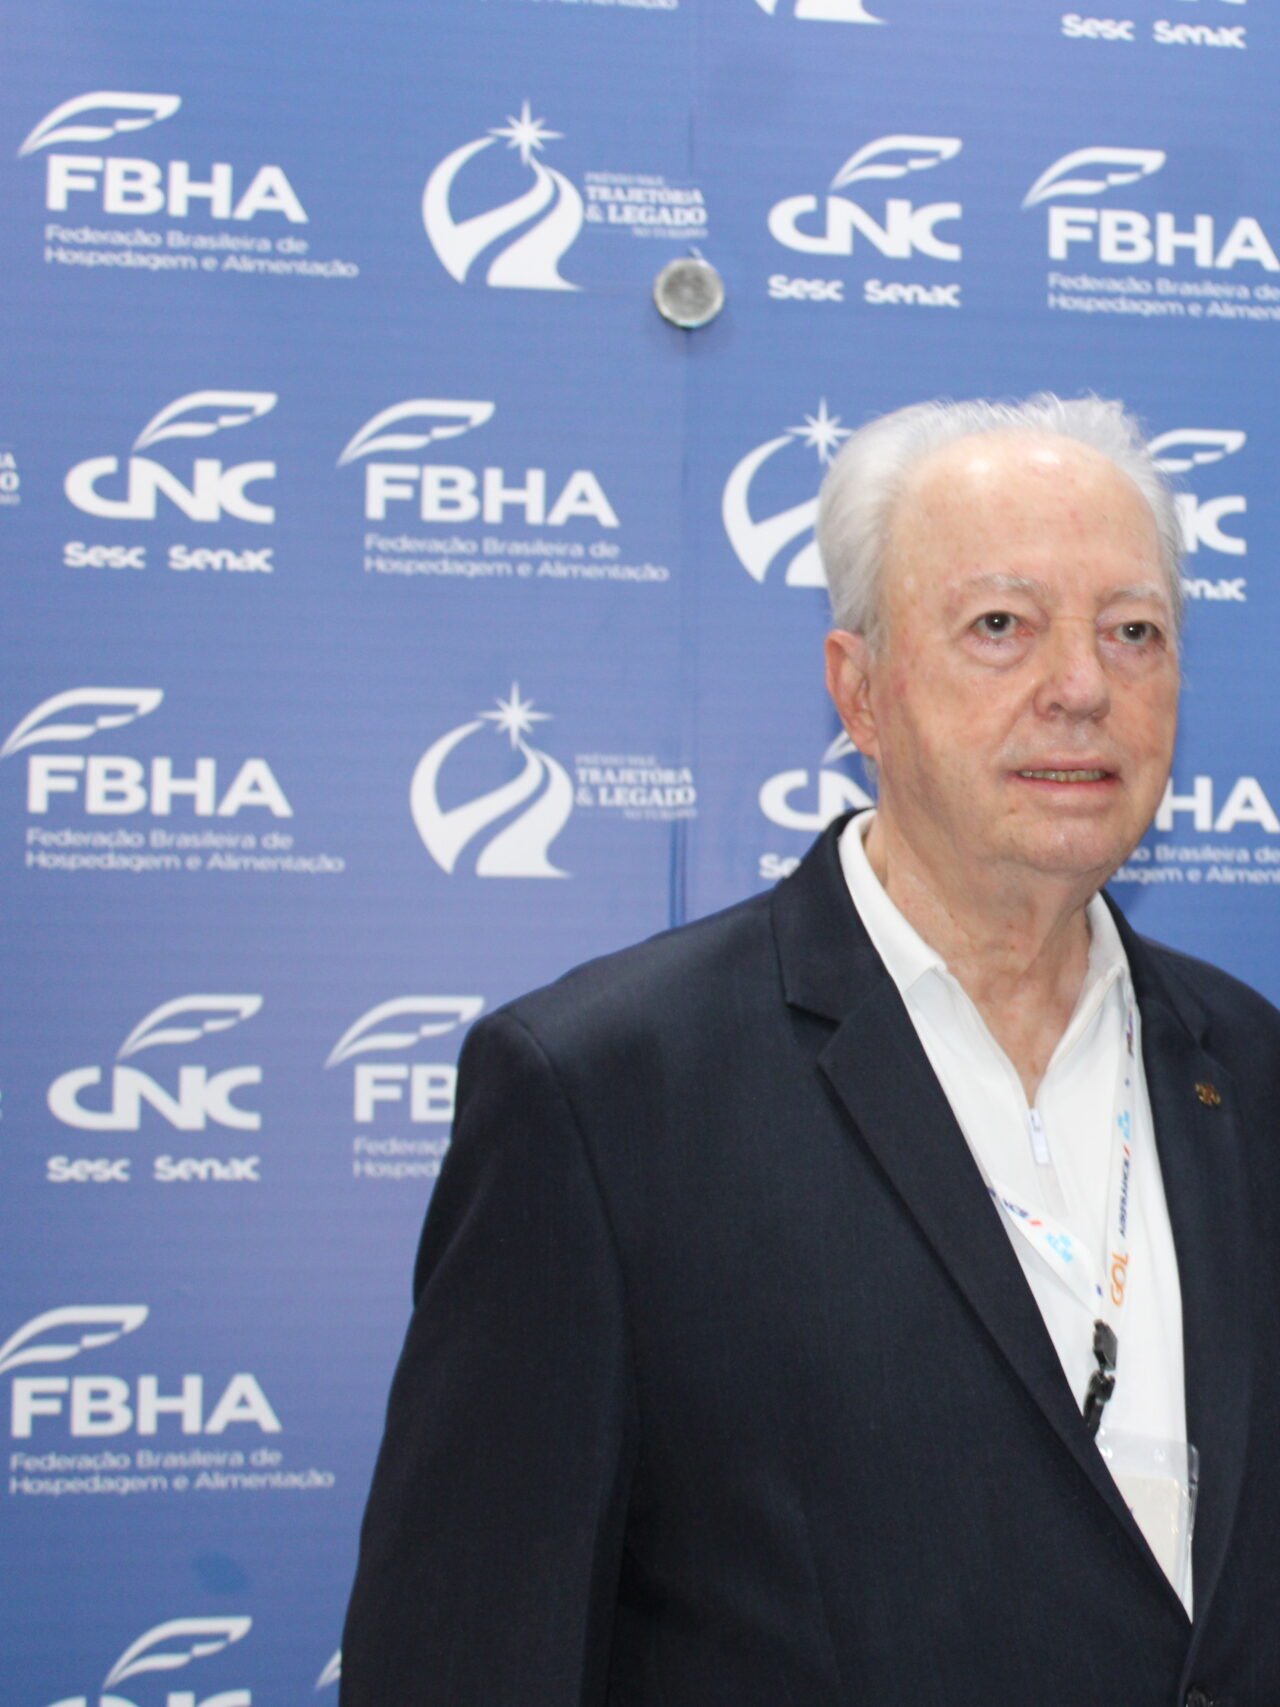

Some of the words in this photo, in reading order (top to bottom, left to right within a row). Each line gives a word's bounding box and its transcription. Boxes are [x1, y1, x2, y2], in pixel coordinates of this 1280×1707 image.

[1061, 13, 1135, 41] Sesc
[1153, 20, 1247, 49] Senac
[47, 154, 309, 223] FBHA
[586, 204, 602, 221] &
[608, 204, 706, 226] LEGADO
[768, 195, 962, 261] CNC
[46, 224, 161, 248] Federação
[167, 230, 270, 252] Brasileira
[276, 237, 308, 254] de
[45, 246, 196, 270] Hospedagem
[202, 256, 218, 270] e
[223, 256, 359, 278] Alimentação
[768, 274, 844, 301] Sesc
[864, 279, 960, 307] Senac
[1048, 273, 1152, 294] Federação
[1156, 278, 1249, 298] Brasileira
[1048, 293, 1183, 317] Hospedagem
[1189, 303, 1202, 316] e
[64, 456, 275, 524] CNC
[365, 463, 620, 528] FBHA
[64, 541, 145, 569] Sesc
[169, 544, 273, 573] Senac
[365, 534, 477, 555] Federação
[482, 537, 584, 557] Brasileira
[590, 541, 620, 559] de
[364, 555, 511, 577] Hospedagem
[517, 564, 532, 577] e
[537, 559, 669, 582] Alimentação
[28, 755, 293, 817] FBHA
[27, 827, 144, 850] Federação
[150, 829, 255, 849] Brasileira
[261, 831, 293, 850] de
[1155, 844, 1249, 862] Brasileira
[26, 849, 180, 872] Hospedagem
[186, 856, 202, 871] e
[207, 851, 344, 874] Alimentação
[1187, 870, 1200, 882] e
[48, 1065, 261, 1131] CNC
[354, 1064, 458, 1122] FB
[47, 1155, 130, 1182] Sesc
[154, 1155, 260, 1181] Senac
[1111, 1252, 1129, 1307] GOL
[11, 1374, 282, 1438] FBHA
[11, 1450, 129, 1473] Federação
[137, 1449, 243, 1470] Brasileira
[250, 1447, 282, 1467] de
[10, 1471, 167, 1496] Hospedagem
[173, 1475, 189, 1490] e
[195, 1468, 334, 1491] Alimentação
